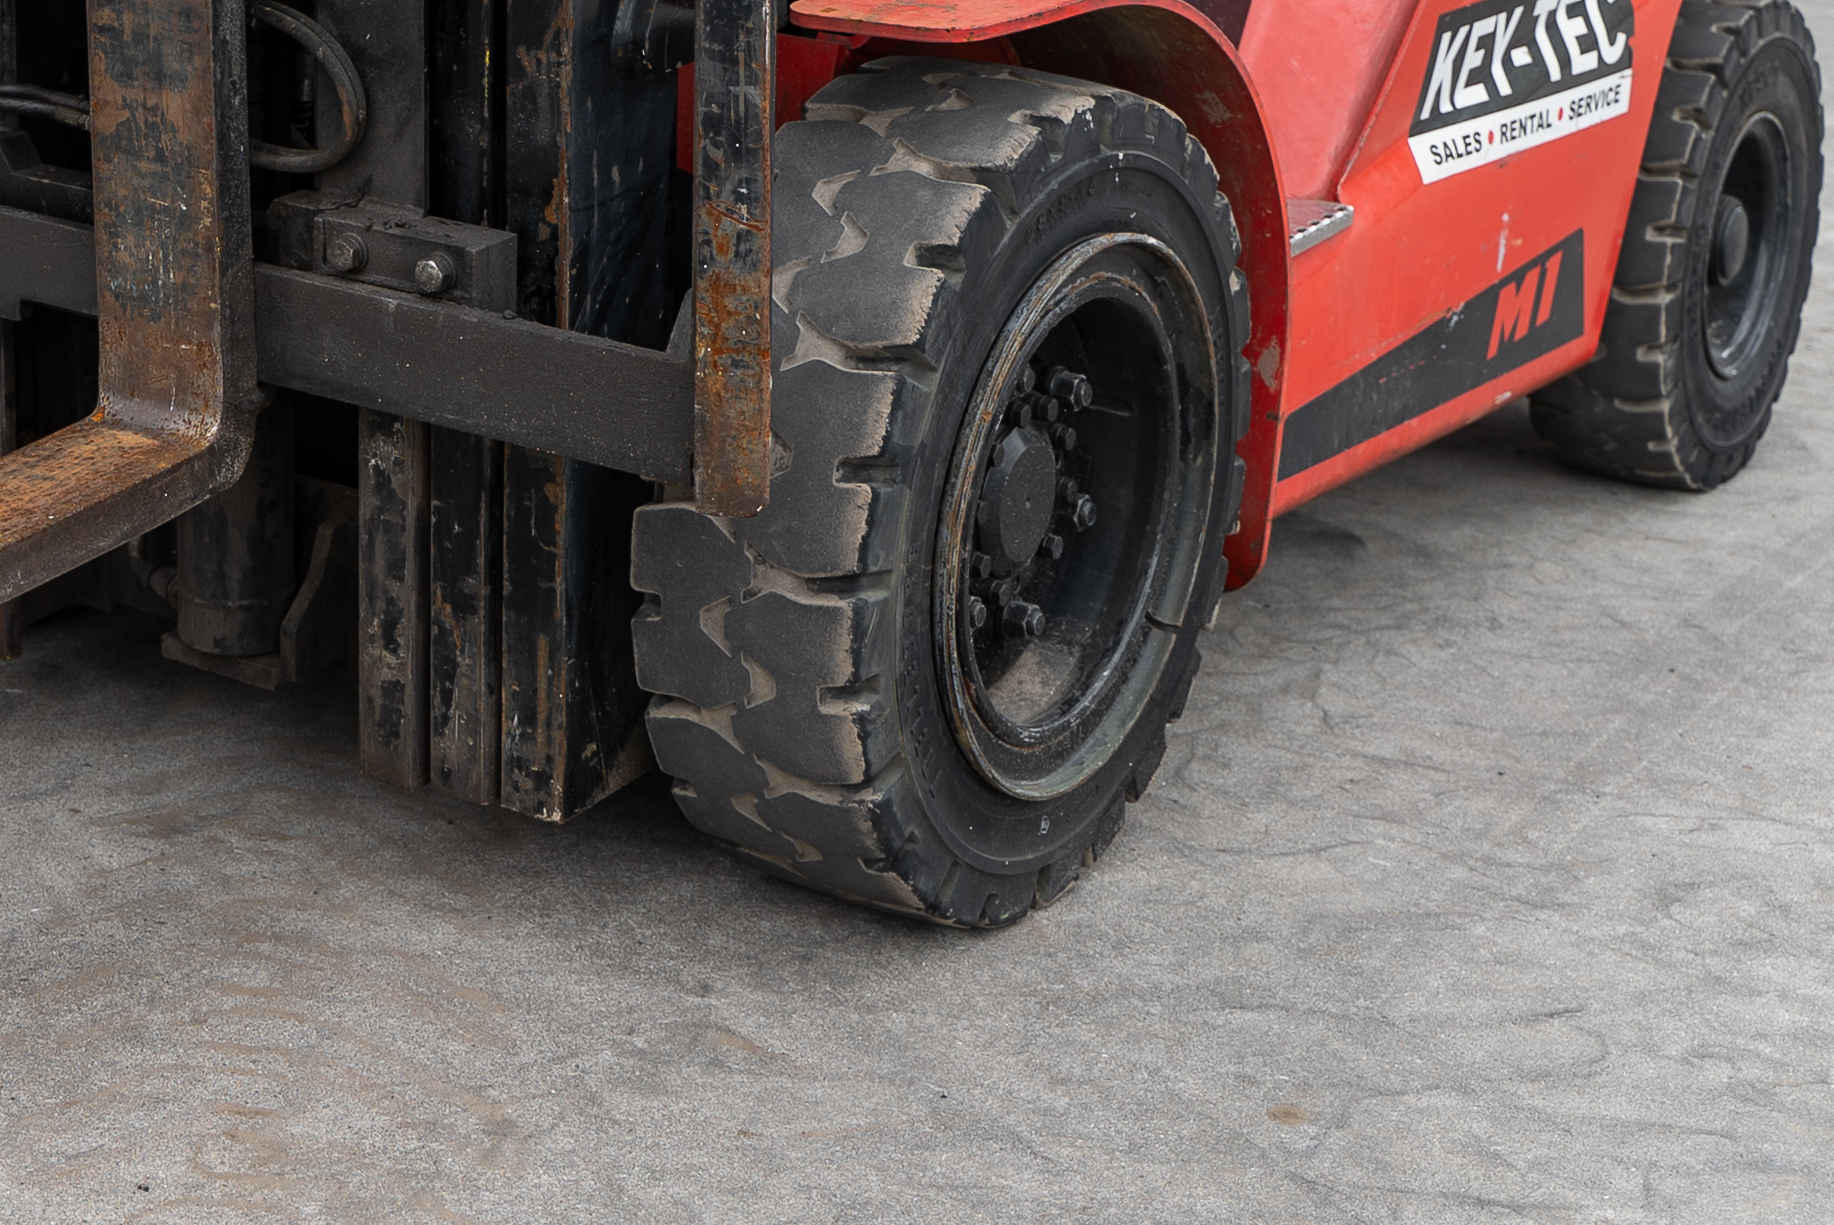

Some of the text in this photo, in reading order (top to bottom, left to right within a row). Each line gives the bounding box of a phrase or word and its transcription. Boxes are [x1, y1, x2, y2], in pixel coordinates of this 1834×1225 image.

[1429, 83, 1622, 166] SALES RENTAL SERVICE
